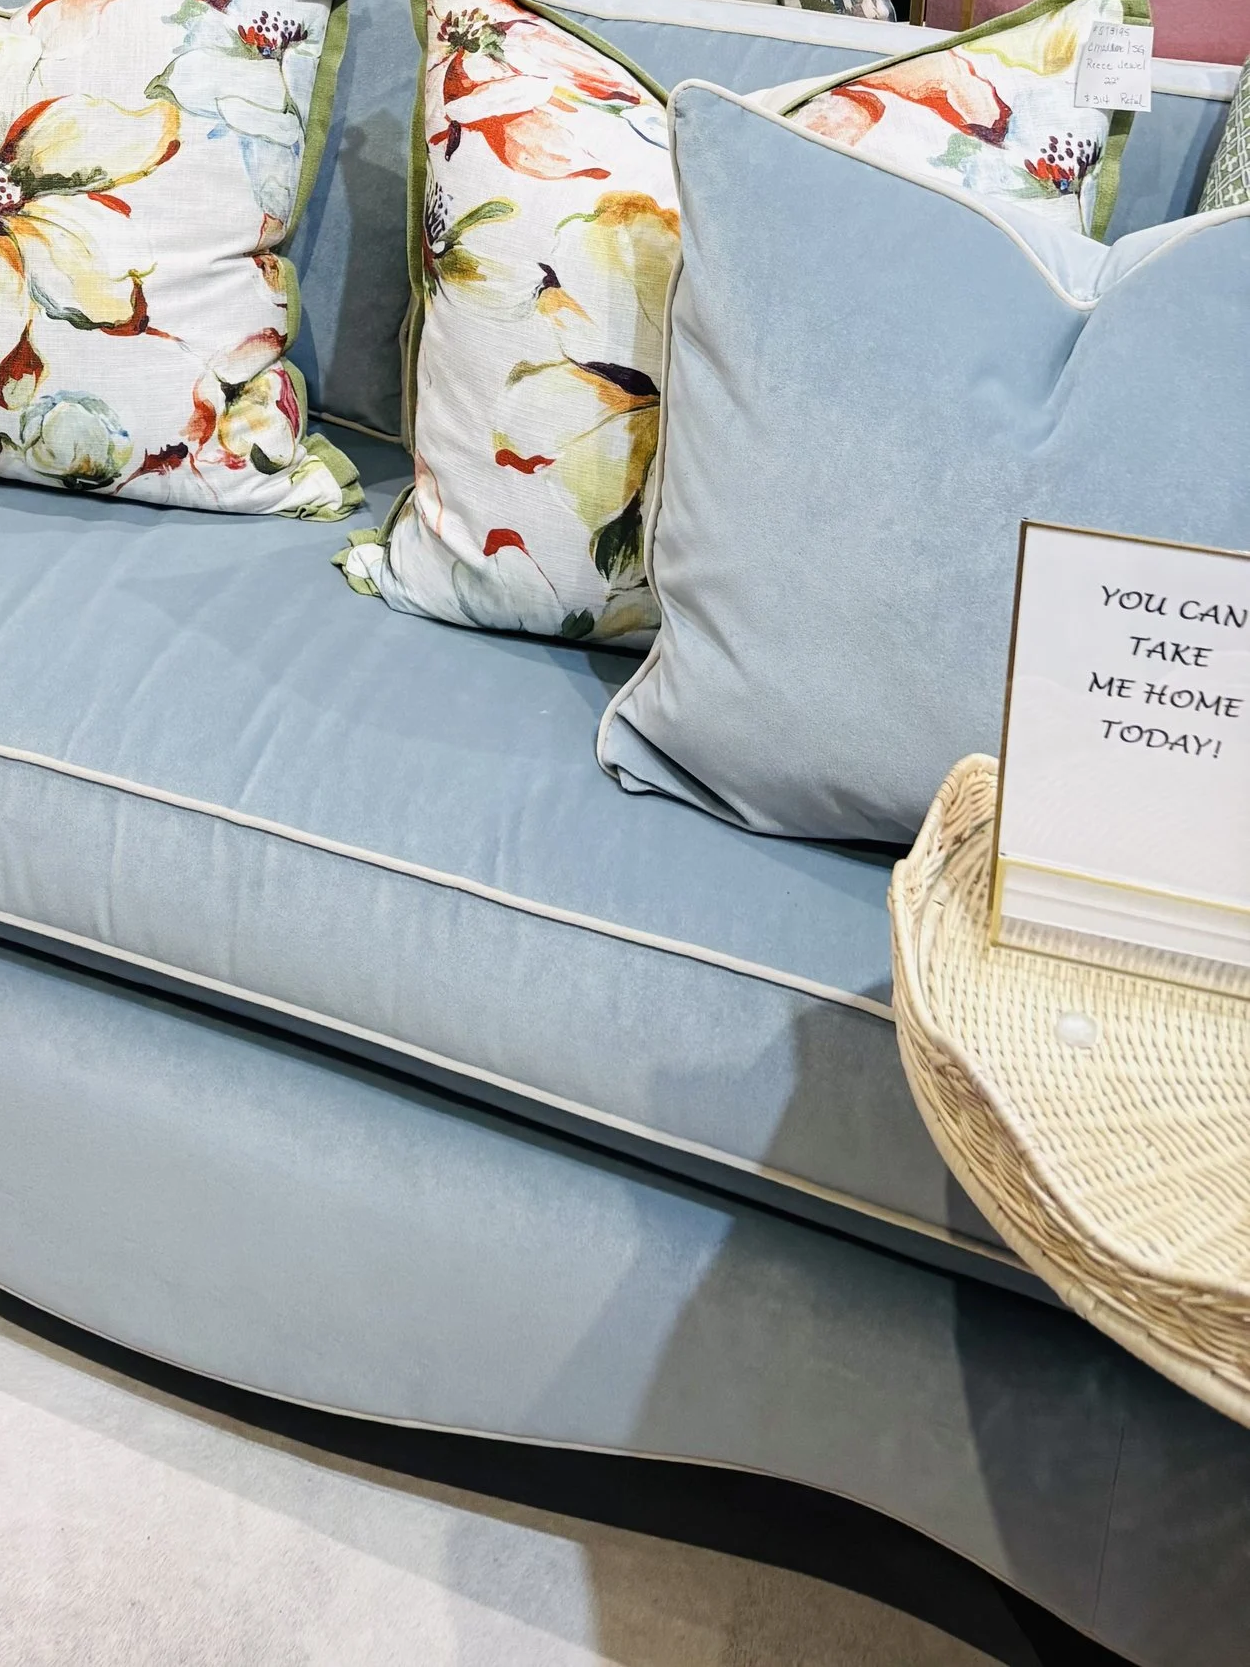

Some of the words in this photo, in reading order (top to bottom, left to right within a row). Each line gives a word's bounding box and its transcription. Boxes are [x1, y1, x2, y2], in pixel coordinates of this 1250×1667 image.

[1101, 585, 1168, 617] YOU
[1179, 599, 1248, 630] CAN
[1129, 635, 1214, 668] TAKE
[1088, 672, 1135, 700] ME
[1144, 682, 1245, 719] HOME
[1101, 719, 1222, 760] TODAY!
